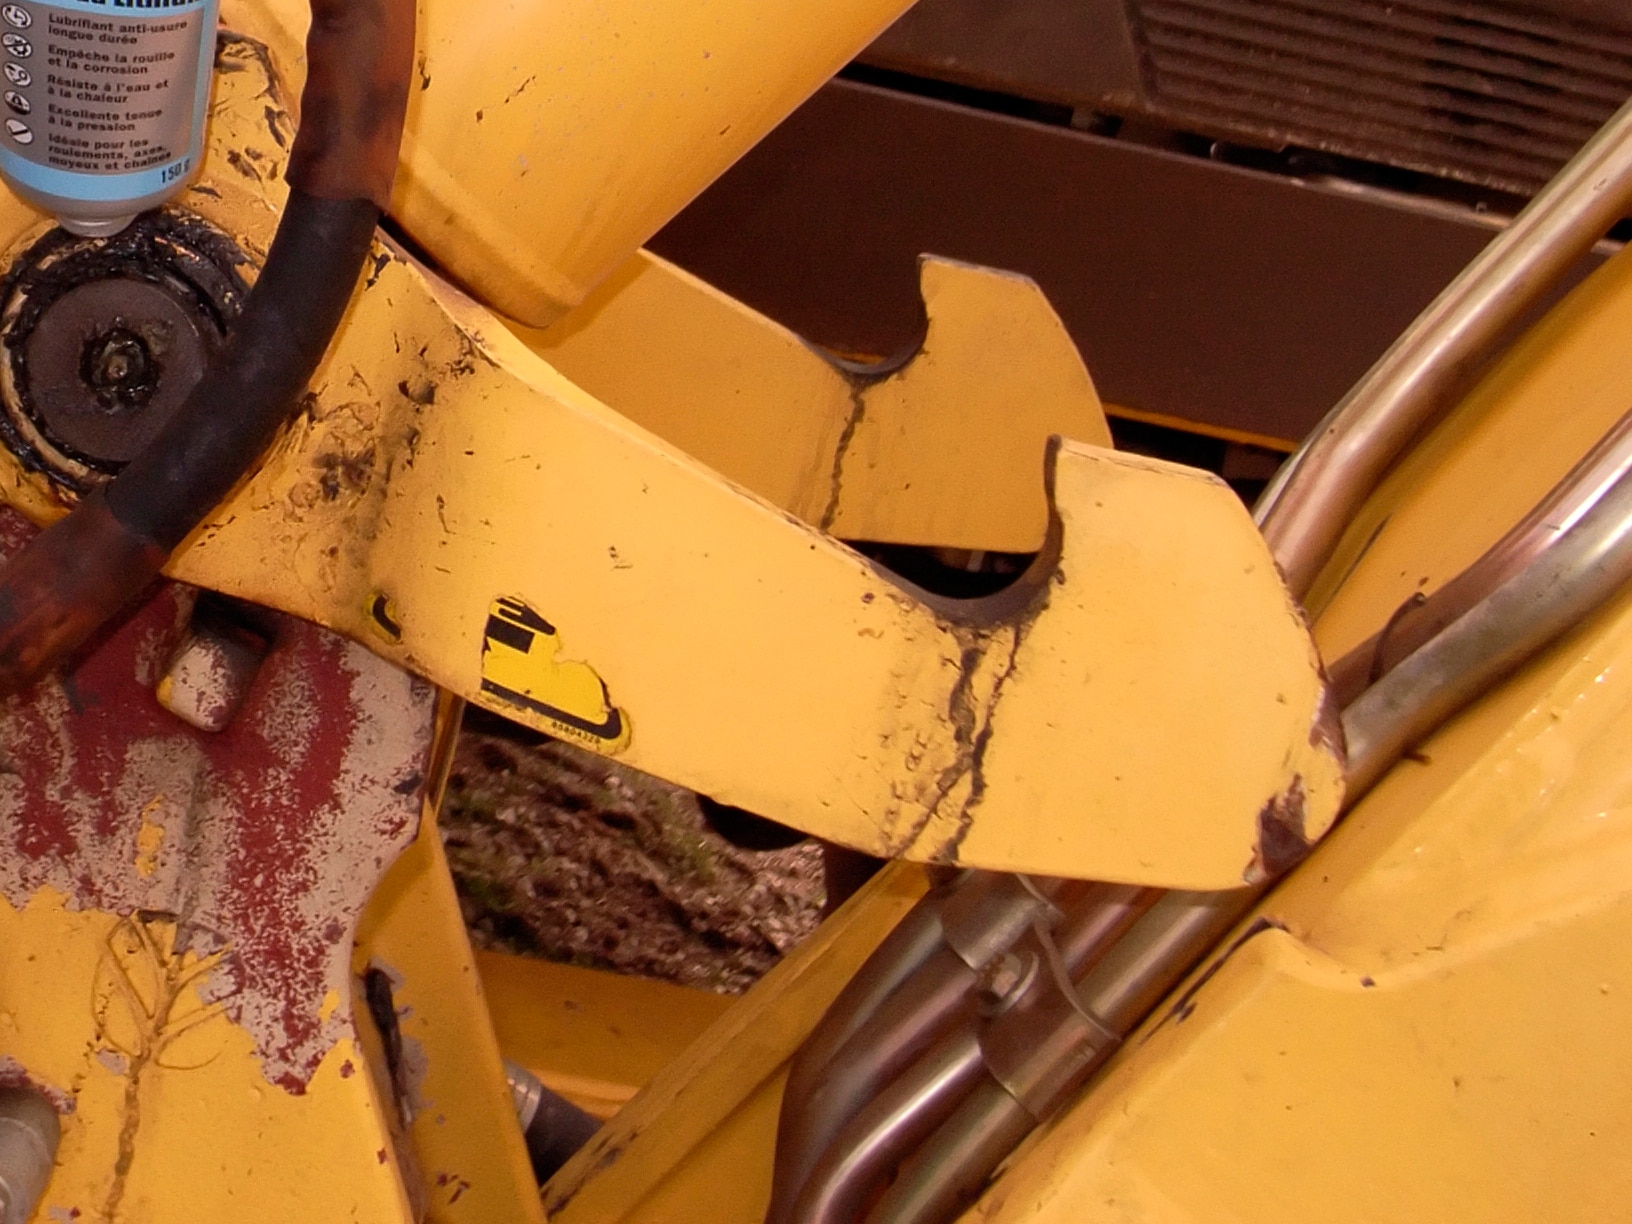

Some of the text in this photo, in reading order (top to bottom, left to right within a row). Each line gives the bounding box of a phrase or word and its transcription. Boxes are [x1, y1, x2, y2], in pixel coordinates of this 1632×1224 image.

[49, 13, 187, 33] Lubrifiant anti-usure
[48, 25, 137, 44] longue durée
[48, 44, 175, 63] Empêche la rouille
[48, 57, 148, 74] et la corrosion
[47, 74, 98, 91] Résiste
[156, 79, 169, 89] et
[60, 88, 72, 98] la
[76, 92, 128, 103] chaleur
[48, 103, 163, 121] Excellente tenue
[60, 117, 73, 127] la
[77, 122, 136, 131] pression
[94, 140, 126, 150] pour
[129, 138, 150, 148] les
[48, 156, 100, 170] moyeux
[104, 161, 119, 170] et
